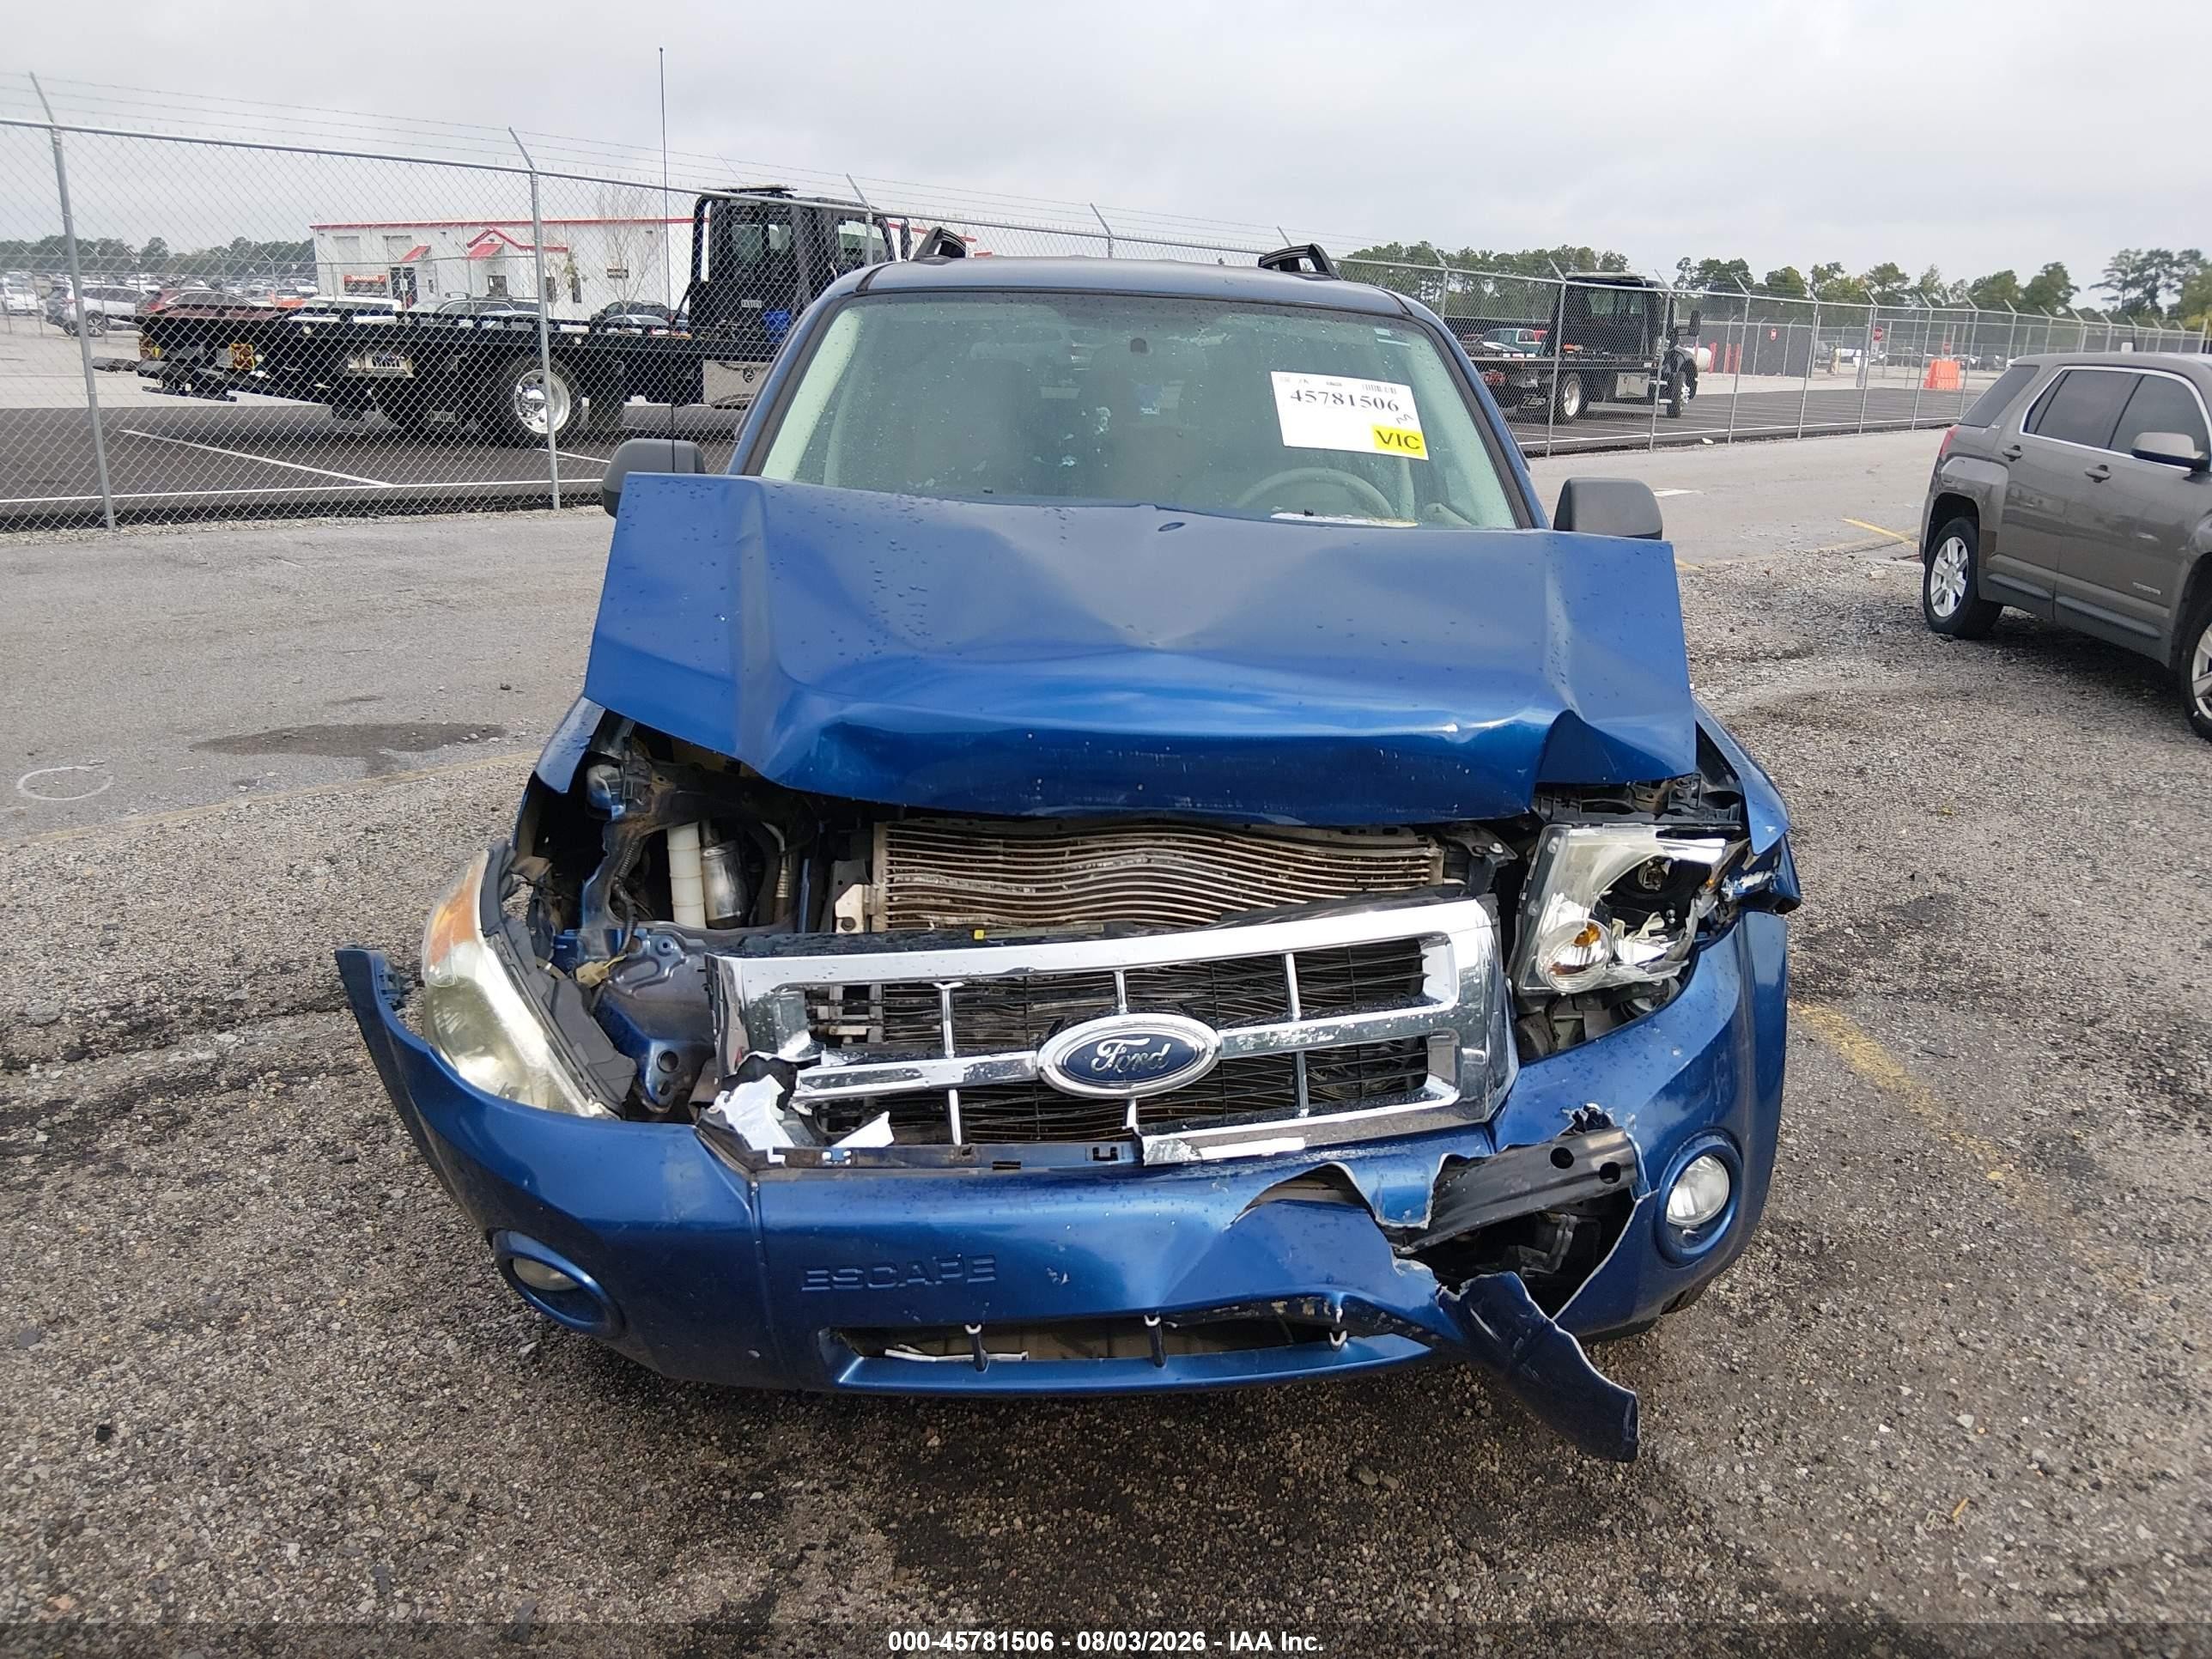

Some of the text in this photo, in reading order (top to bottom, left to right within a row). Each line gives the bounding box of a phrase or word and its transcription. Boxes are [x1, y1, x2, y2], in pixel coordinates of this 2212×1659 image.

[1290, 389, 1400, 412] 45781506
[1376, 429, 1421, 450] VIC
[1090, 1037, 1172, 1073] Ford
[801, 1255, 997, 1291] ESCAPE
